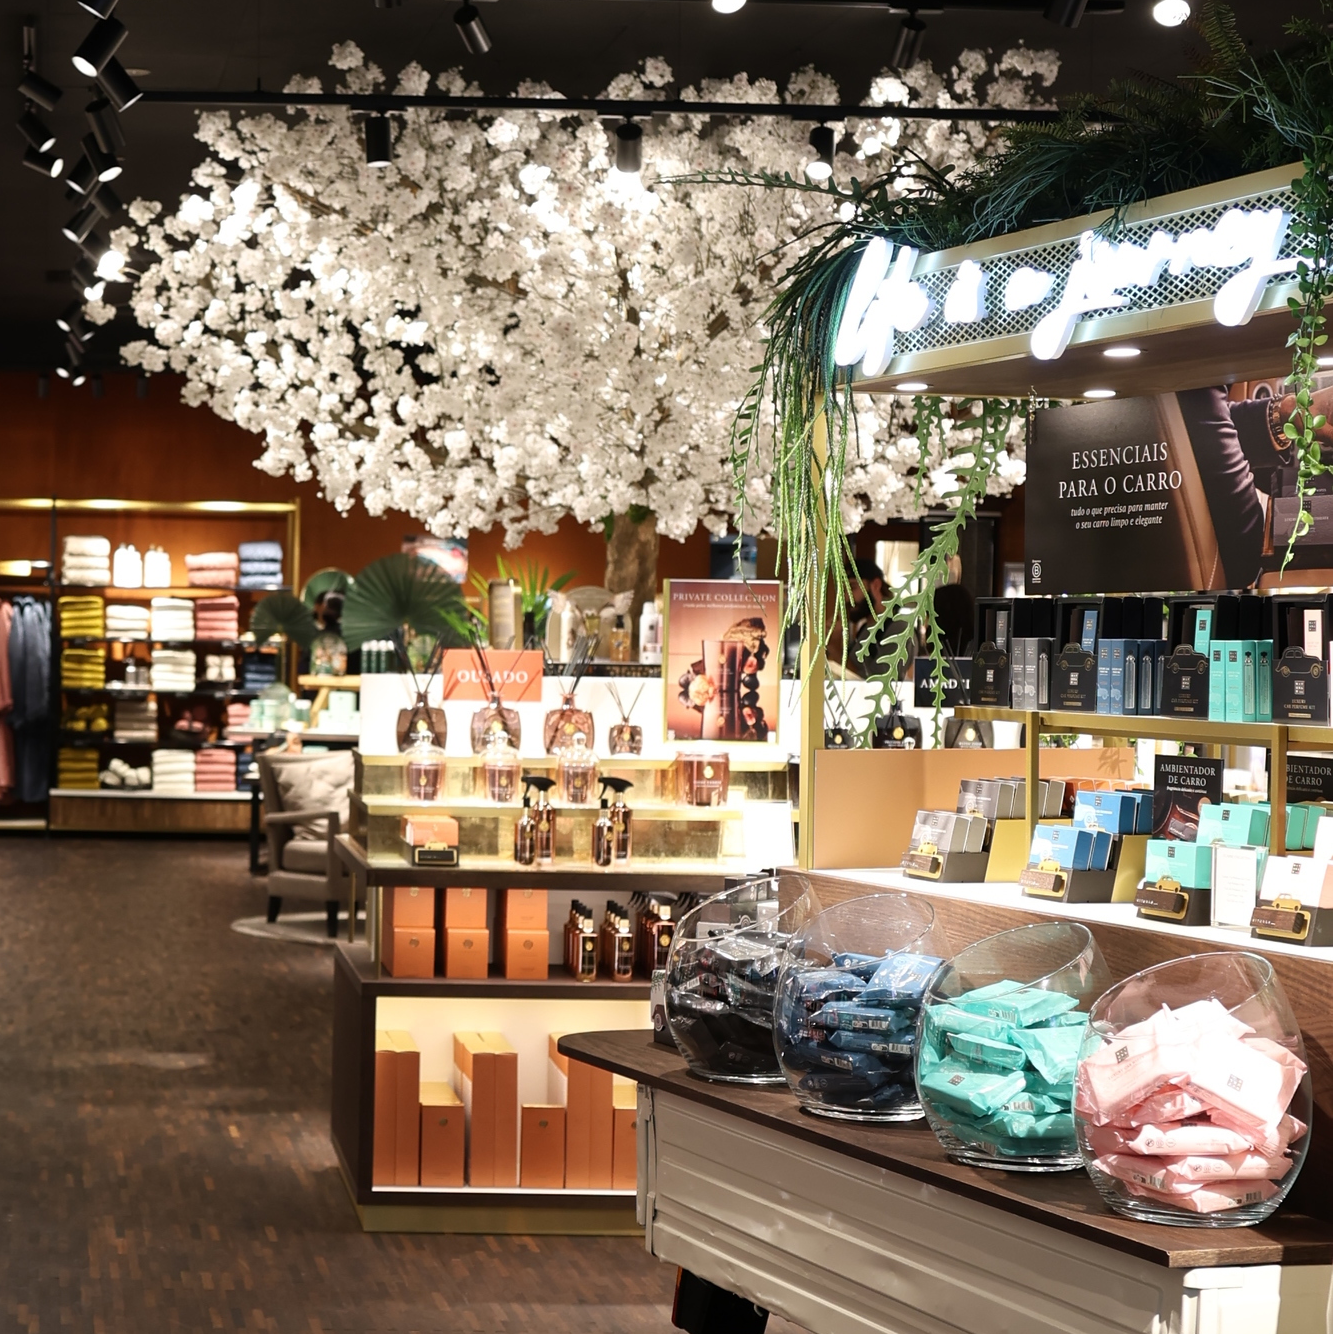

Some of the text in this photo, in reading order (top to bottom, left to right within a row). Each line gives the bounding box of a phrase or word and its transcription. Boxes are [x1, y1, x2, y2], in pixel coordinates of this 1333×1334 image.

[1072, 441, 1168, 470] ESSENCIAIS
[1059, 470, 1183, 499] PARA O CARRO
[1070, 506, 1085, 517] tudo
[1091, 508, 1103, 518] que
[1103, 505, 1127, 518] precisa
[1127, 505, 1144, 517] para
[1144, 501, 1169, 512] manter
[1110, 517, 1129, 528] limpo
[1135, 515, 1163, 527] elegante
[673, 593, 712, 601] PRIVATE
[920, 678, 970, 690] AMADI
[1160, 763, 1216, 776] AMBIENTADOR
[1286, 764, 1332, 776] BIENTADOR
[1168, 775, 1207, 787] DE CARRO
[1295, 776, 1323, 786] CARRO
